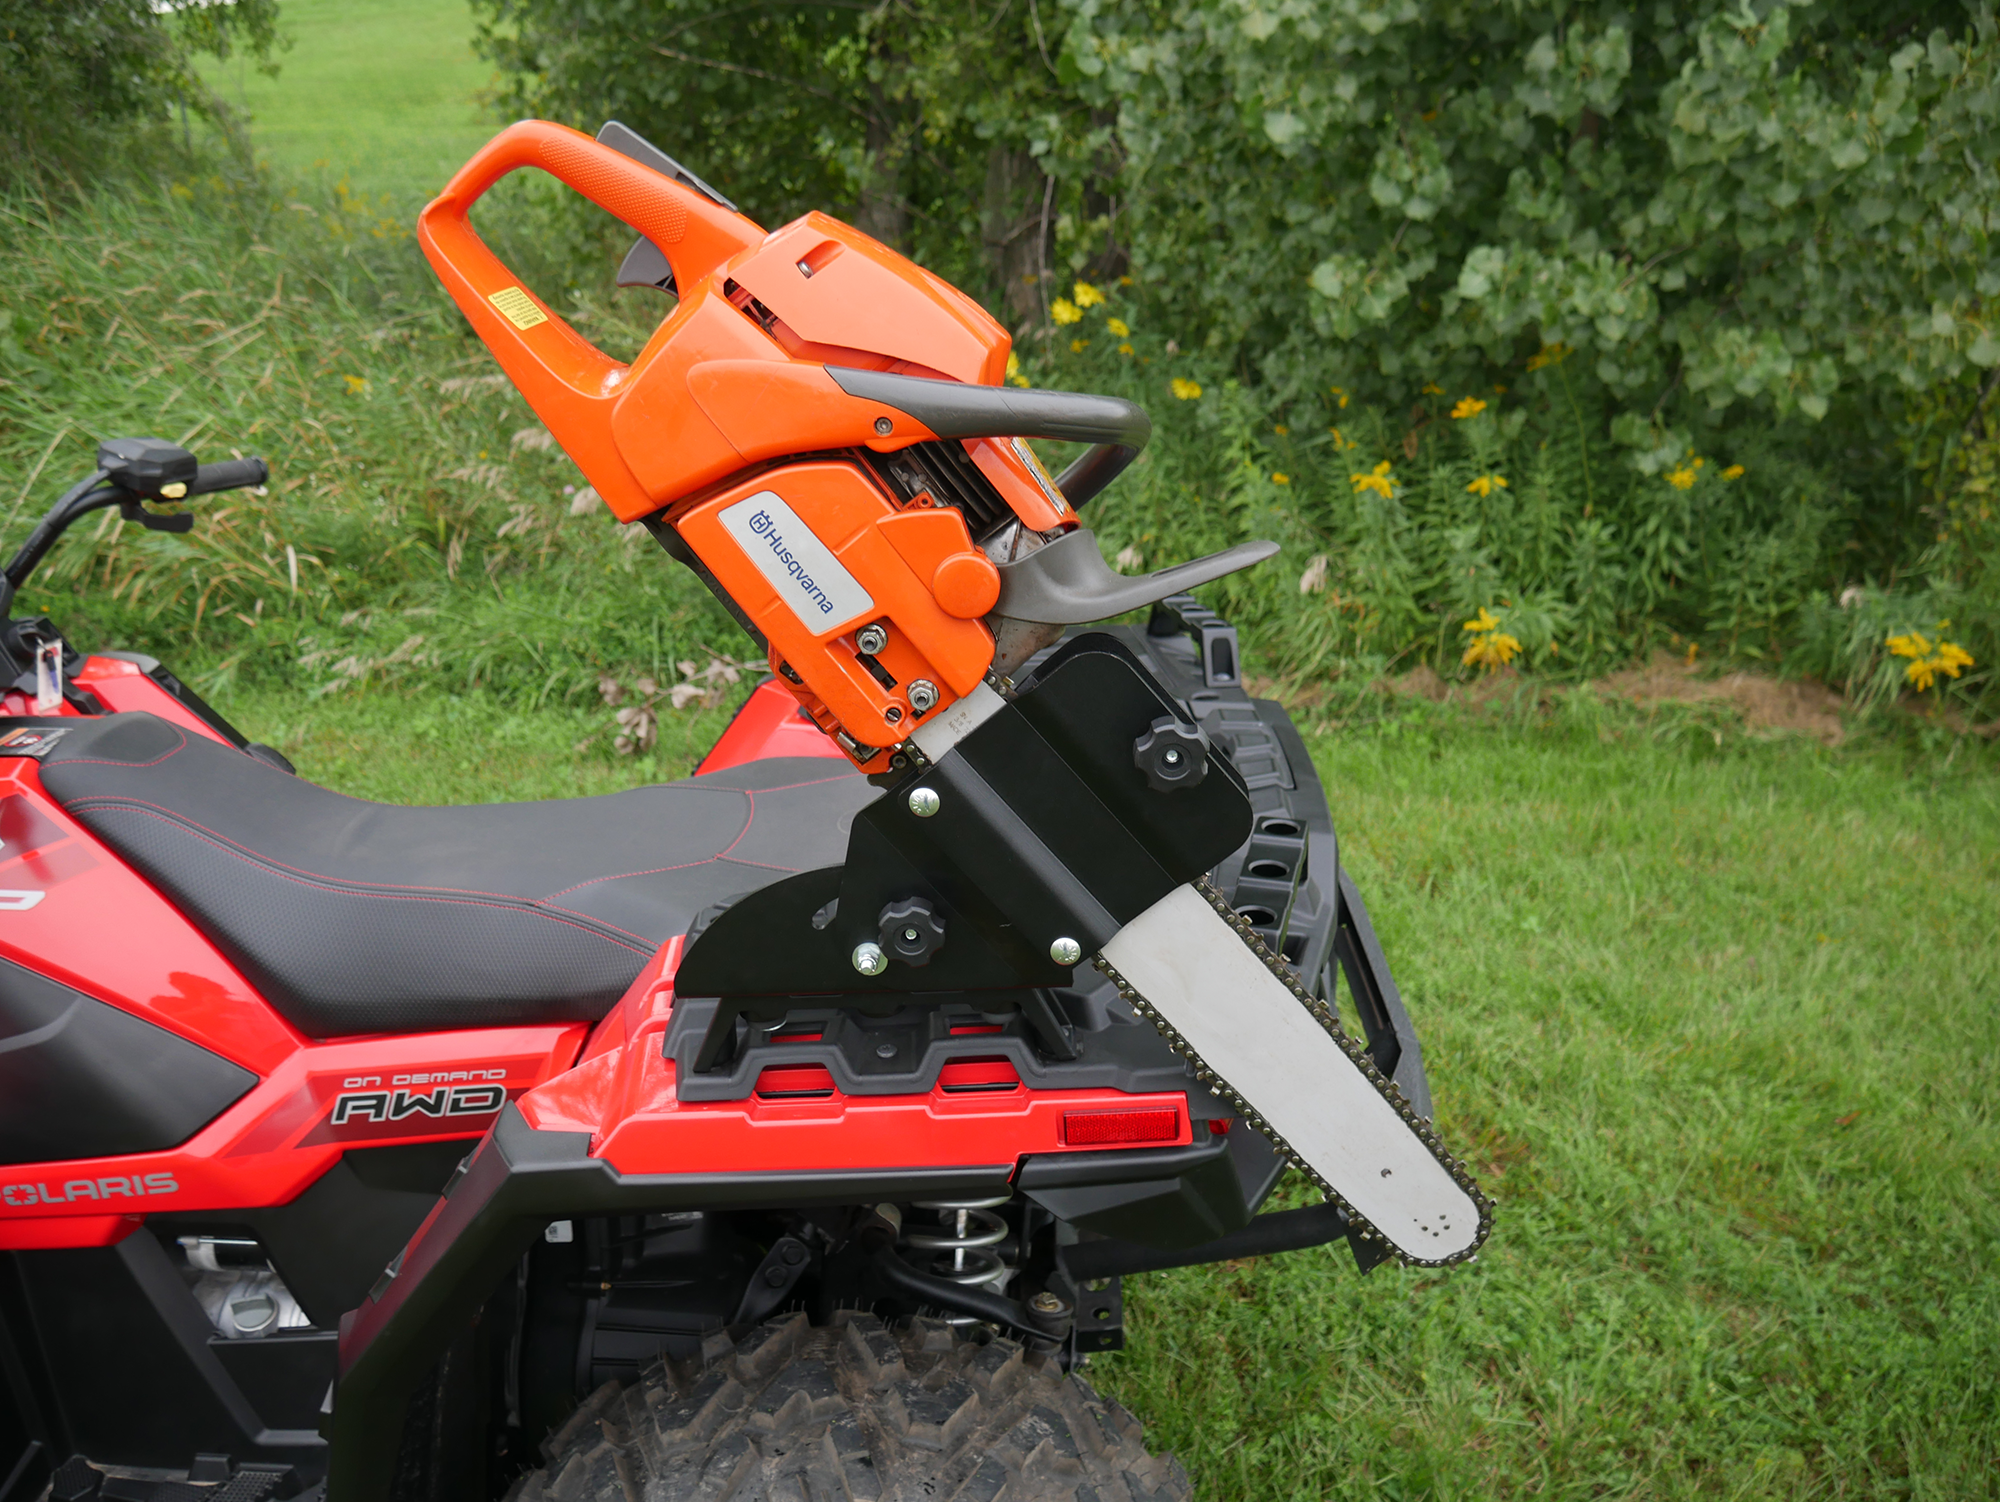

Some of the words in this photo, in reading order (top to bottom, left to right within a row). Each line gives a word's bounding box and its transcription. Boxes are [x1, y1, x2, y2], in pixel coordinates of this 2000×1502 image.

[763, 528, 834, 615] Husqvarna
[343, 1076, 382, 1088] ON
[392, 1069, 507, 1085] DEMAND
[331, 1083, 507, 1125] AWD
[0, 1172, 179, 1207] OLARIS
